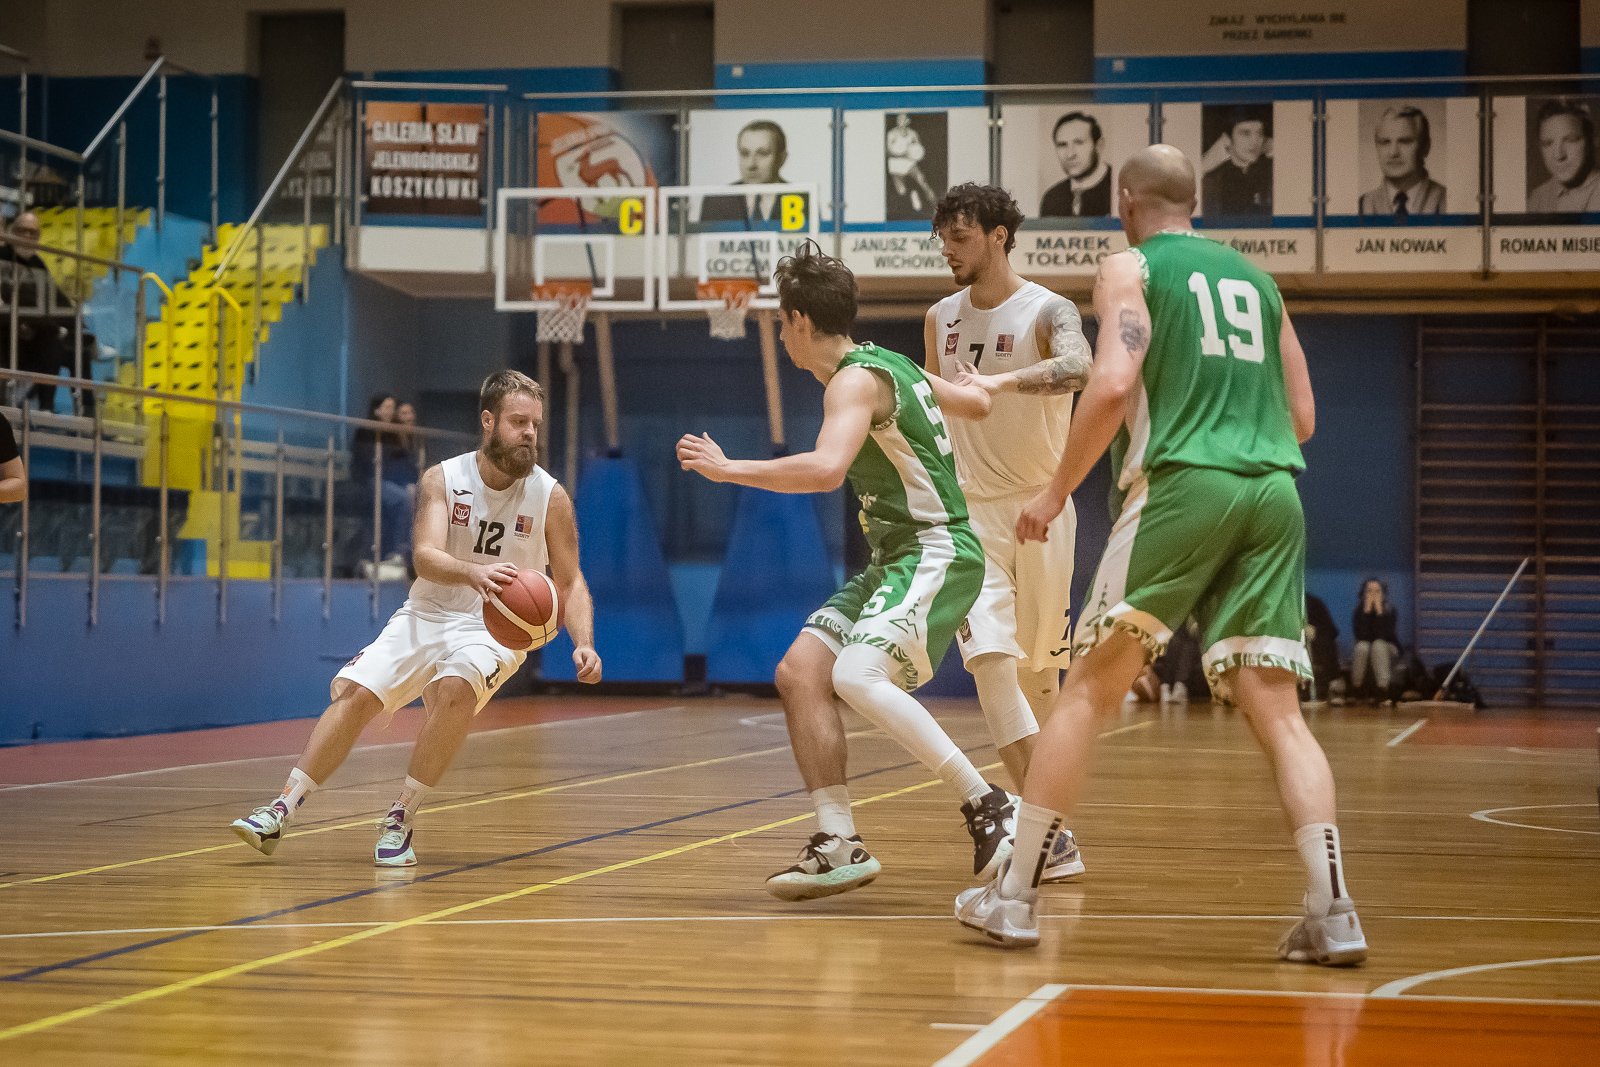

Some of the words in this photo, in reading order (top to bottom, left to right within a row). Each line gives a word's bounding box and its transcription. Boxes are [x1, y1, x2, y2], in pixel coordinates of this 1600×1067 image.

[371, 121, 432, 143] GALERIA
[619, 198, 643, 235] C
[781, 194, 805, 231] B
[851, 237, 908, 252] JANUSZ
[1035, 236, 1110, 250] MAREK
[1355, 238, 1385, 253] JAN
[1390, 238, 1447, 253] NOWAK
[1500, 238, 1557, 253] ROMAN
[1187, 271, 1265, 364] 19
[968, 343, 985, 370] 7
[473, 520, 506, 557] 12
